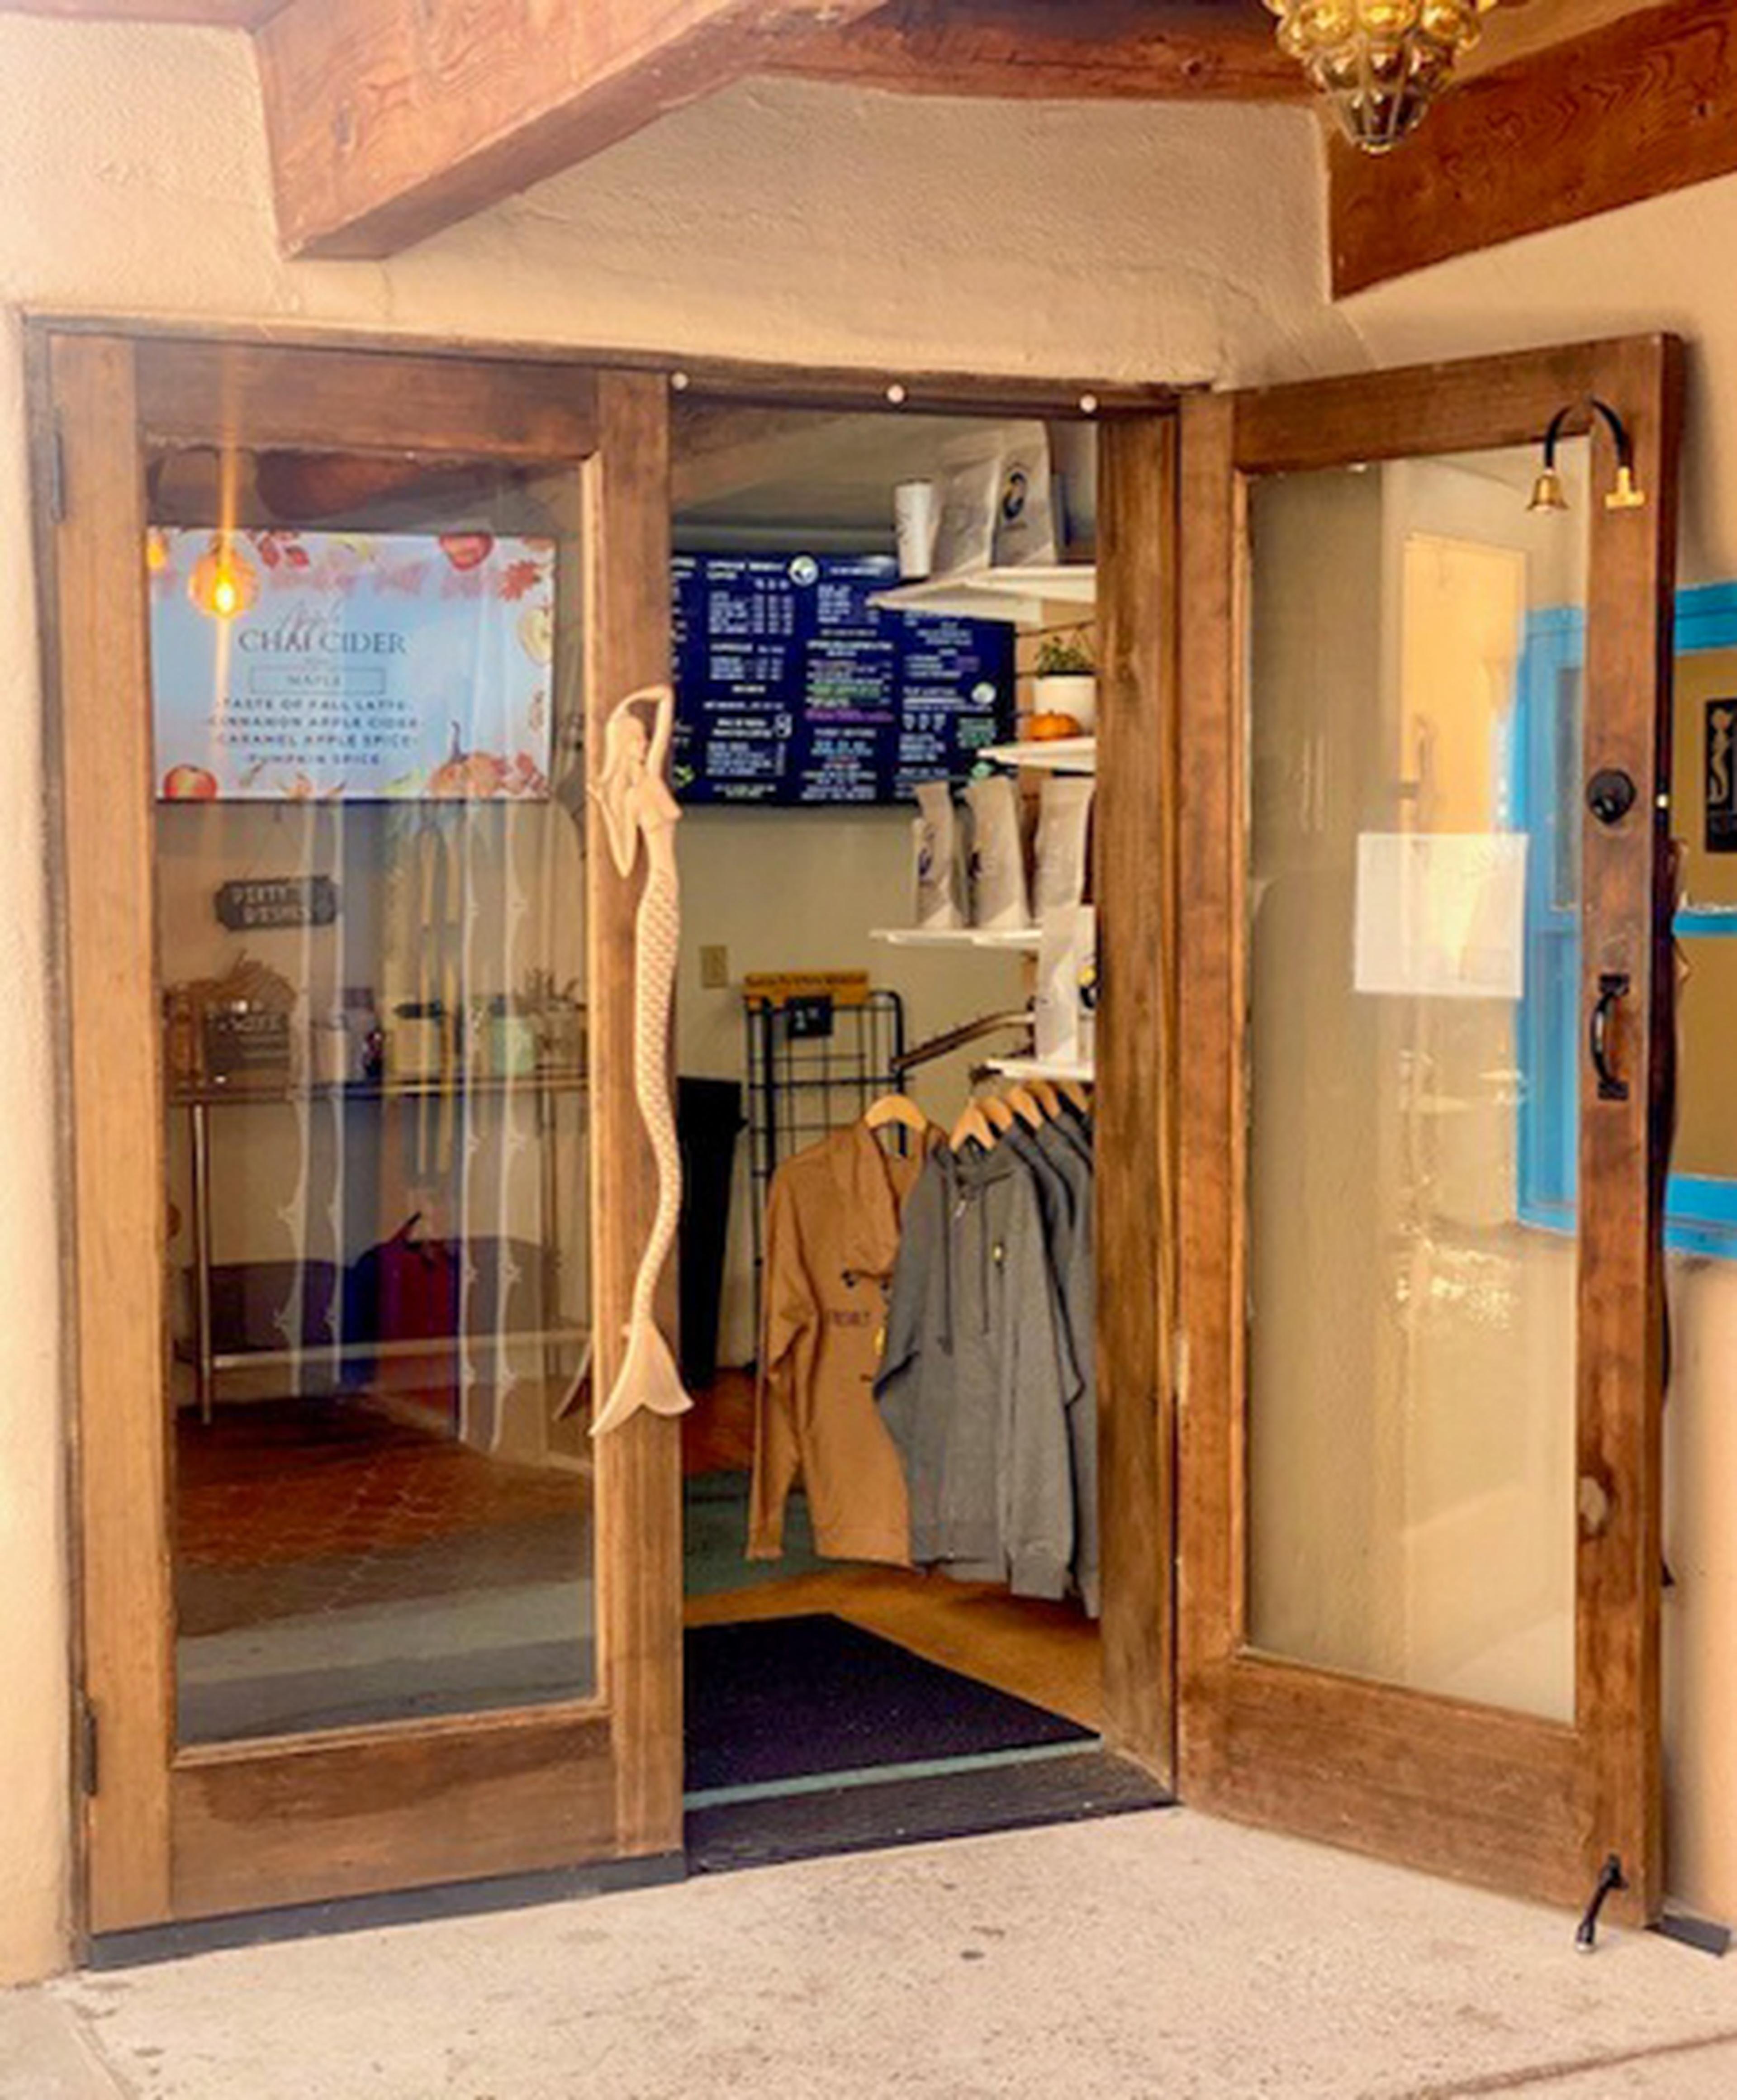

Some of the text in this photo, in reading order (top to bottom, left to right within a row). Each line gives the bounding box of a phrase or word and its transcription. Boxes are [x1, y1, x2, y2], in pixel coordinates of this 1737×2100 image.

[237, 629, 407, 653] CHAI CIDER
[223, 698, 272, 710] TASTE
[308, 699, 350, 711] FALL
[354, 700, 404, 712] LATTE
[308, 717, 361, 728] APPLE
[304, 734, 357, 747] APPLE
[363, 734, 411, 748] SPICE
[332, 754, 380, 766] SPICE
